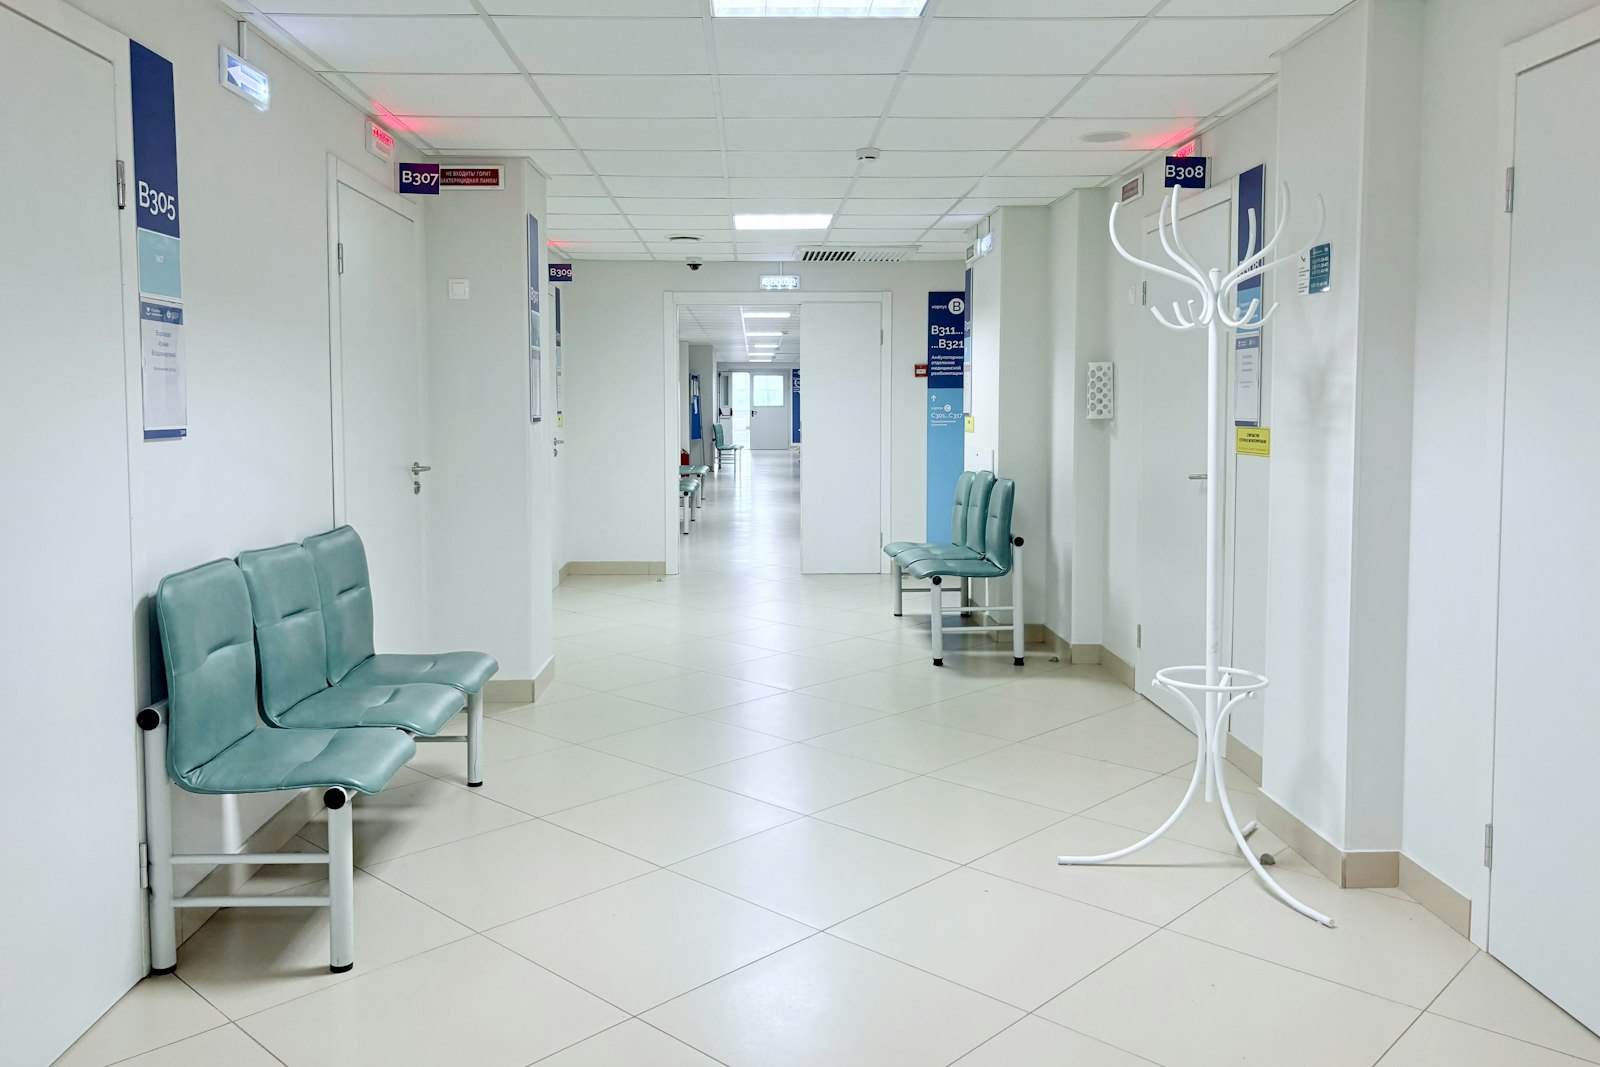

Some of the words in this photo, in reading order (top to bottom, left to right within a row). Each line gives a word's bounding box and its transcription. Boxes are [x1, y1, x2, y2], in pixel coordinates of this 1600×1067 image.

[402, 170, 439, 186] B307
[1165, 164, 1204, 180] B308
[138, 180, 176, 221] B305
[550, 268, 572, 277] B309
